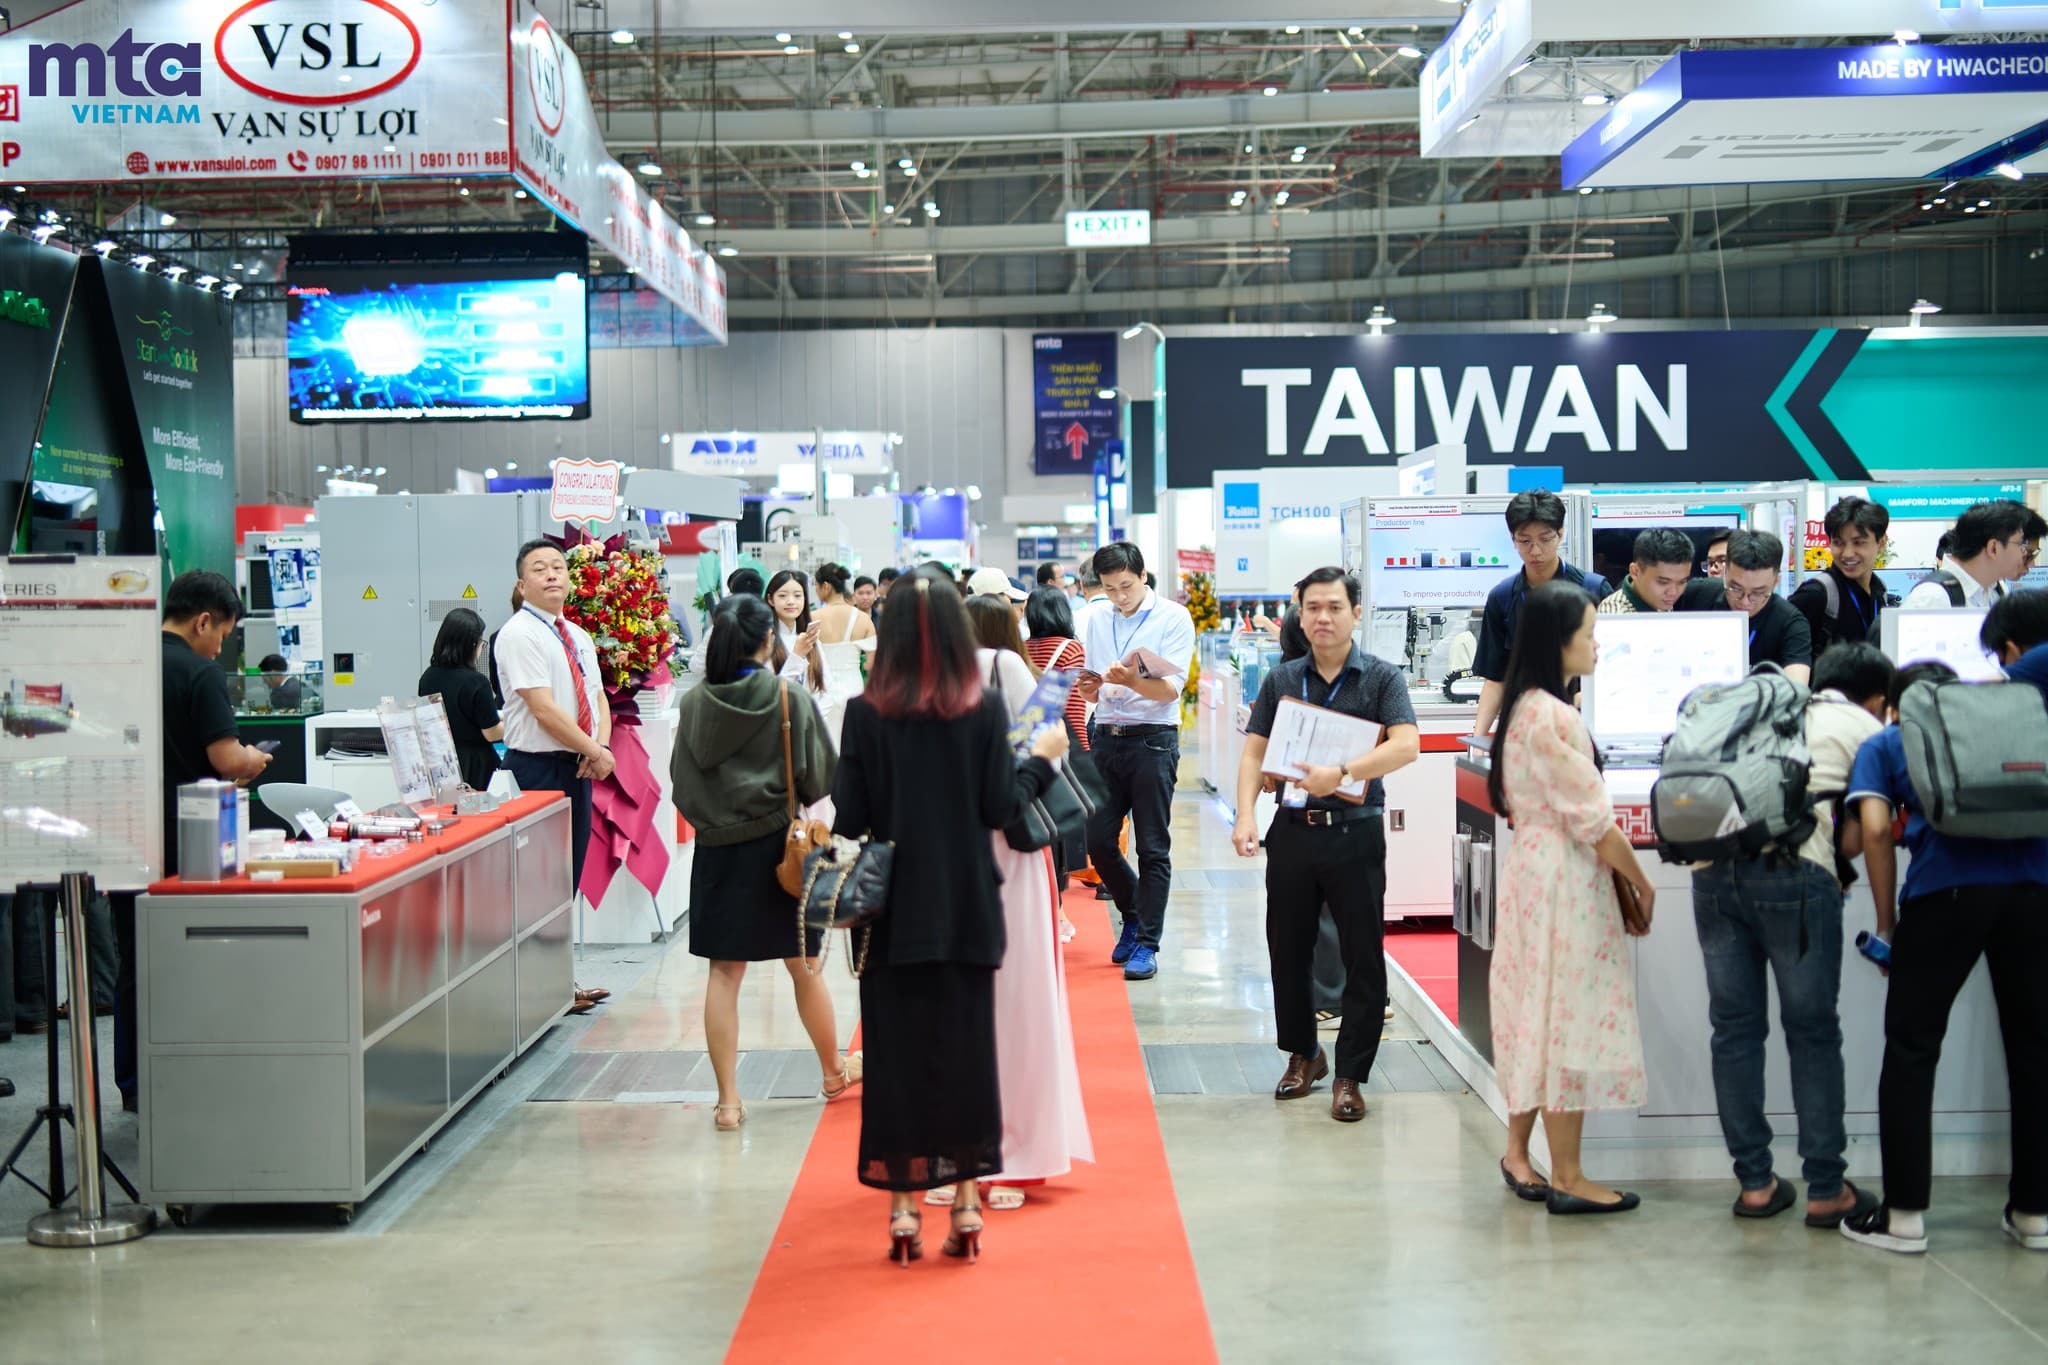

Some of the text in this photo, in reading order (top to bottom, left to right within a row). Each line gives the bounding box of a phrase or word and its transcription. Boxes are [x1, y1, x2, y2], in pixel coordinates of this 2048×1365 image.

[250, 22, 382, 70] VSL
[1838, 56, 2048, 80] MADE BY HWACHEO
[534, 47, 559, 111] VSL
[212, 106, 419, 144] VẠN SỰ LỢI
[155, 153, 402, 173] www.vansuloi.com 0907 98 1111
[420, 150, 508, 168] 0901 011 888
[1084, 216, 1129, 232] EXIT
[1242, 364, 1687, 455] TAIWAN
[153, 426, 171, 446] More
[165, 452, 224, 480] More Eco-Friendly
[559, 471, 614, 490] CONGRATULATIONS
[1888, 497, 1928, 507] MANFORD
[1929, 496, 1976, 506] MACHINERY
[1271, 506, 1331, 519] TCH100
[1376, 519, 1411, 527] Production
[1402, 589, 1485, 599] To improve productivity
